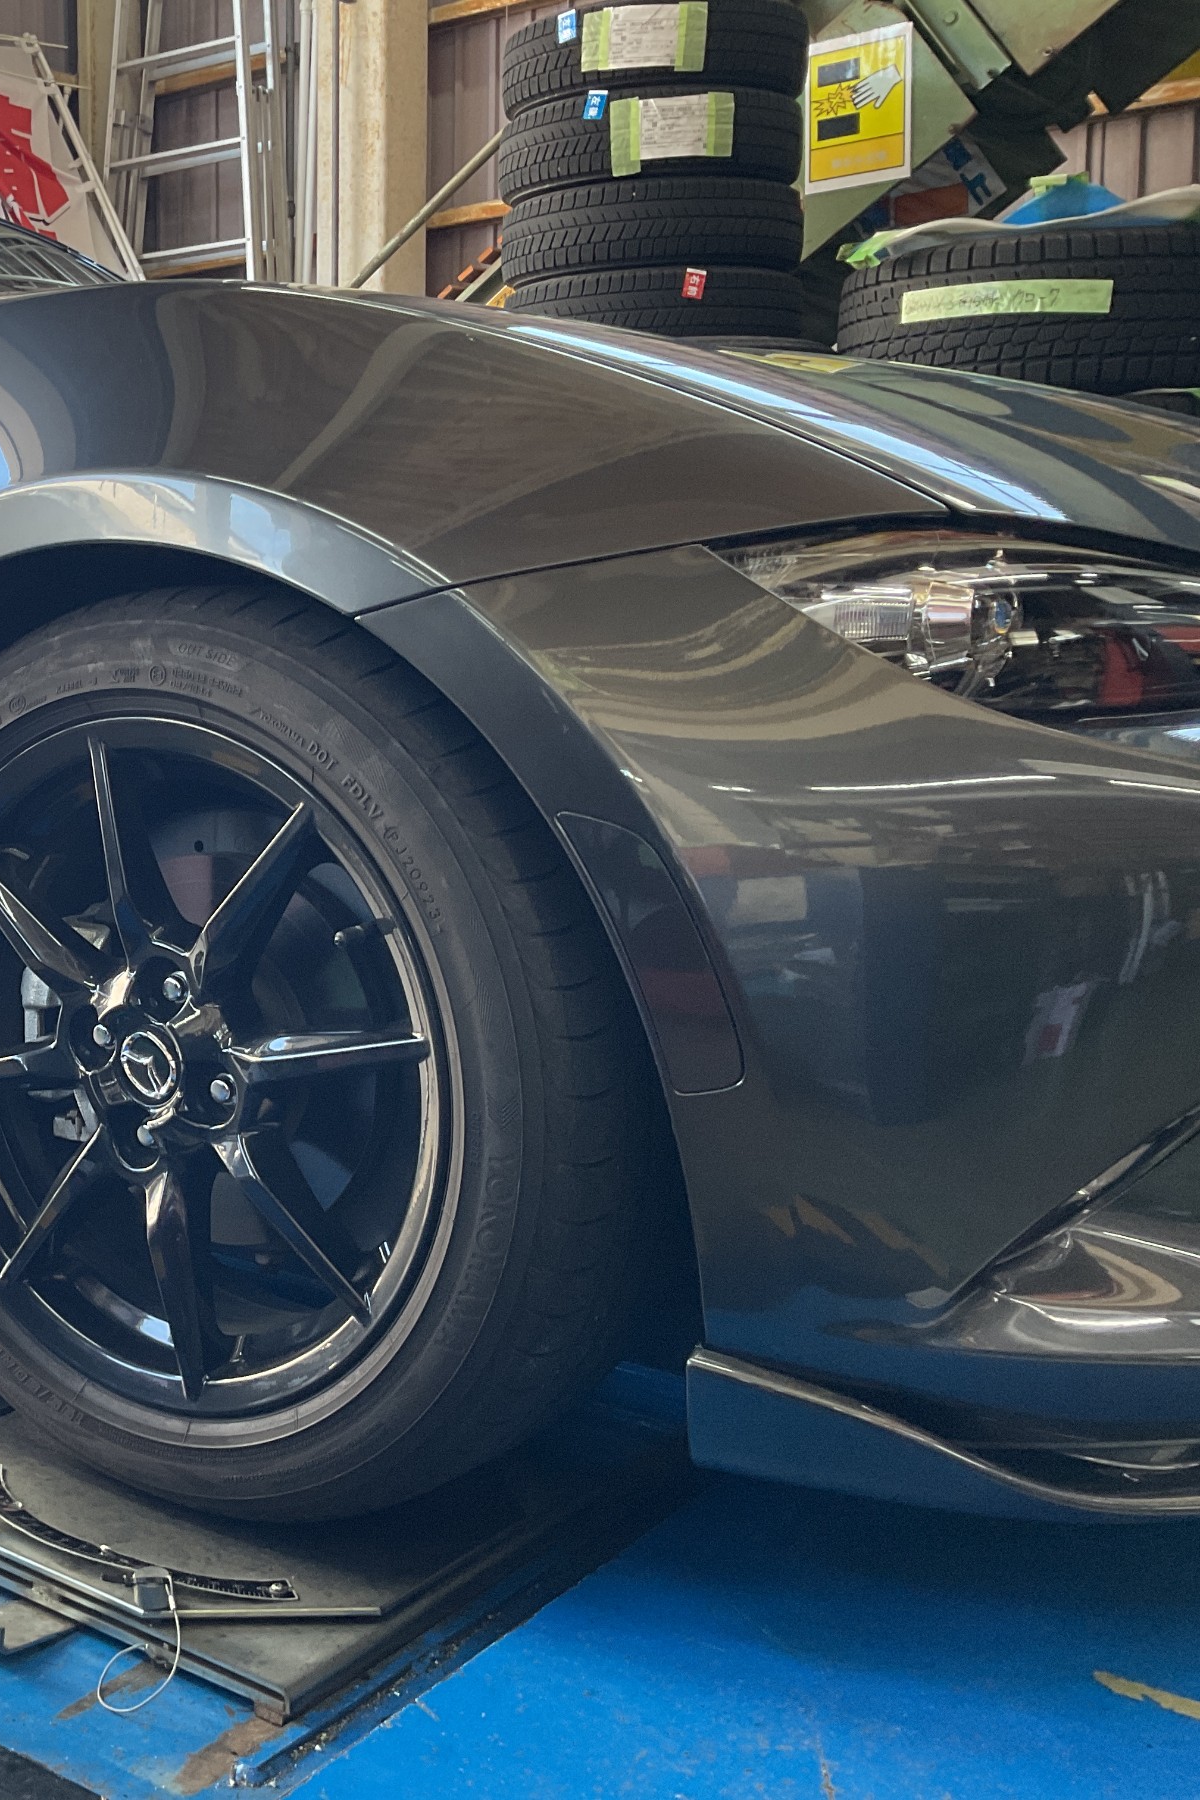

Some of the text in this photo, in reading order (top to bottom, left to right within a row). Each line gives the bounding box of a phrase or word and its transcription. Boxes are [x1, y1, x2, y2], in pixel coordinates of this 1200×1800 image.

[178, 643, 237, 667] OUT SIDE
[307, 740, 340, 771] DOT
[341, 773, 384, 821] FDLV
